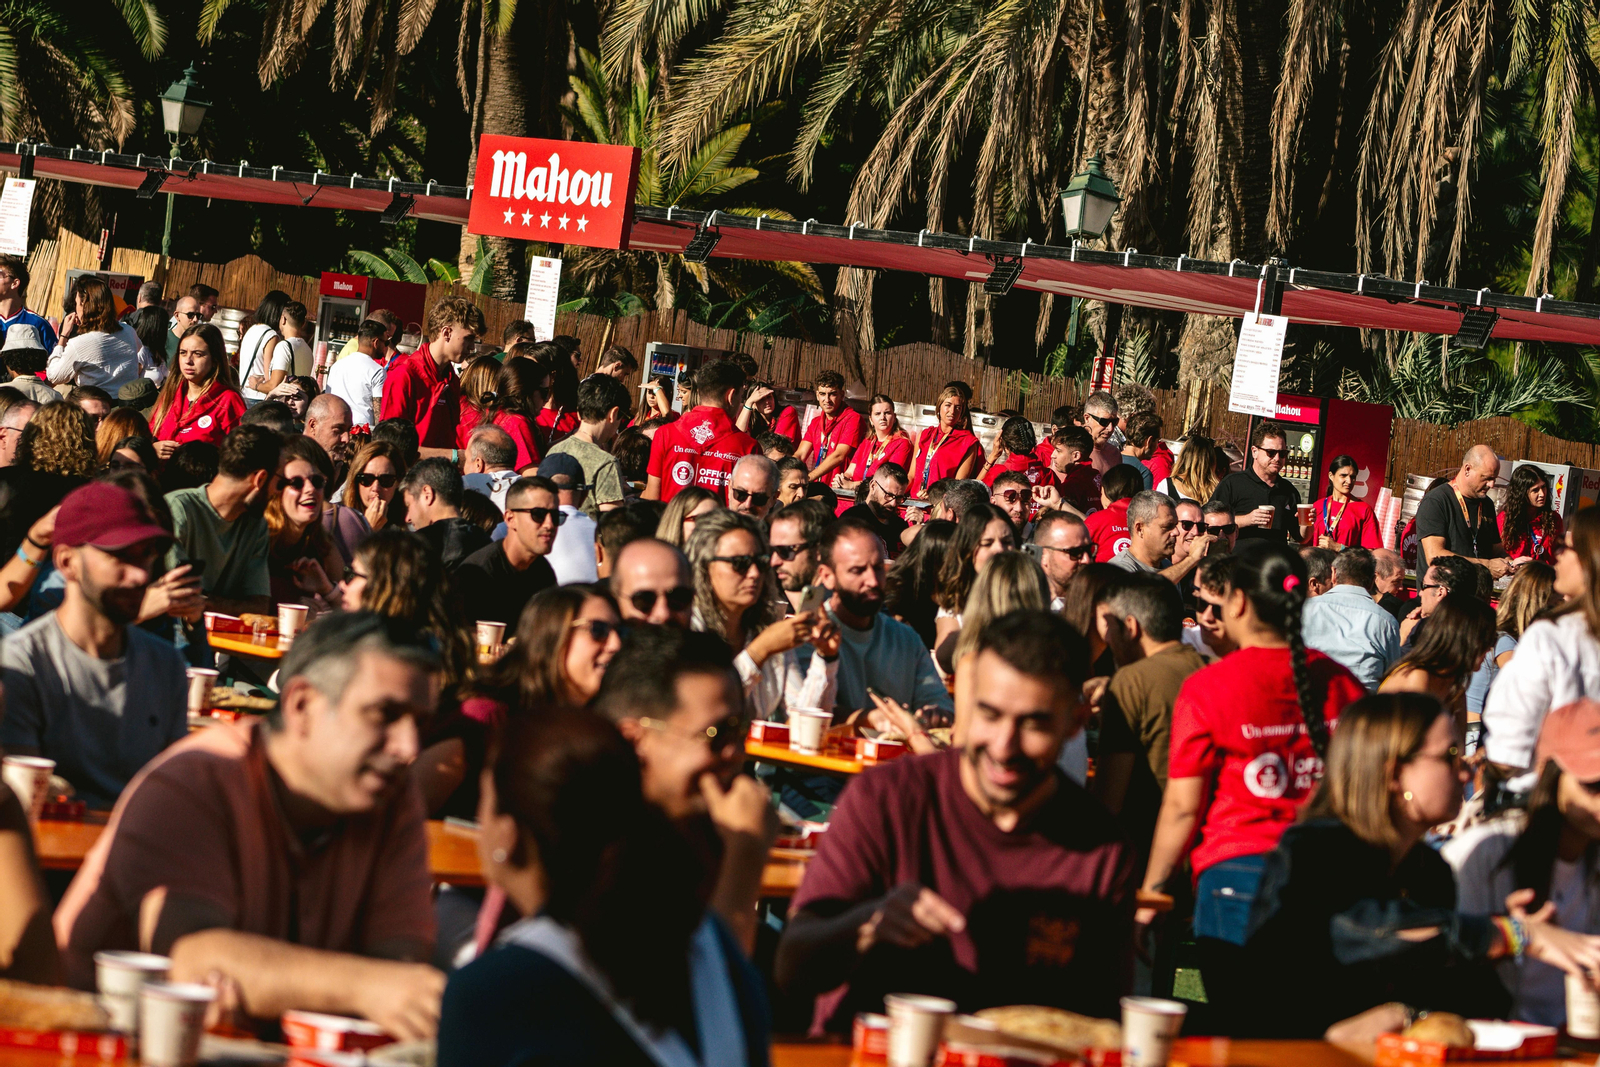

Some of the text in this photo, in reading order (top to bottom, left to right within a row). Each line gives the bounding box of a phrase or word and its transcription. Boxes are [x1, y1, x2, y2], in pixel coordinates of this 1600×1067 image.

[490, 150, 613, 208] Mahou
[109, 278, 127, 289] Red
[333, 281, 353, 291] Mahou
[674, 445, 684, 453] Un
[699, 467, 732, 479] OFFICIA
[1241, 723, 1262, 739] Un
